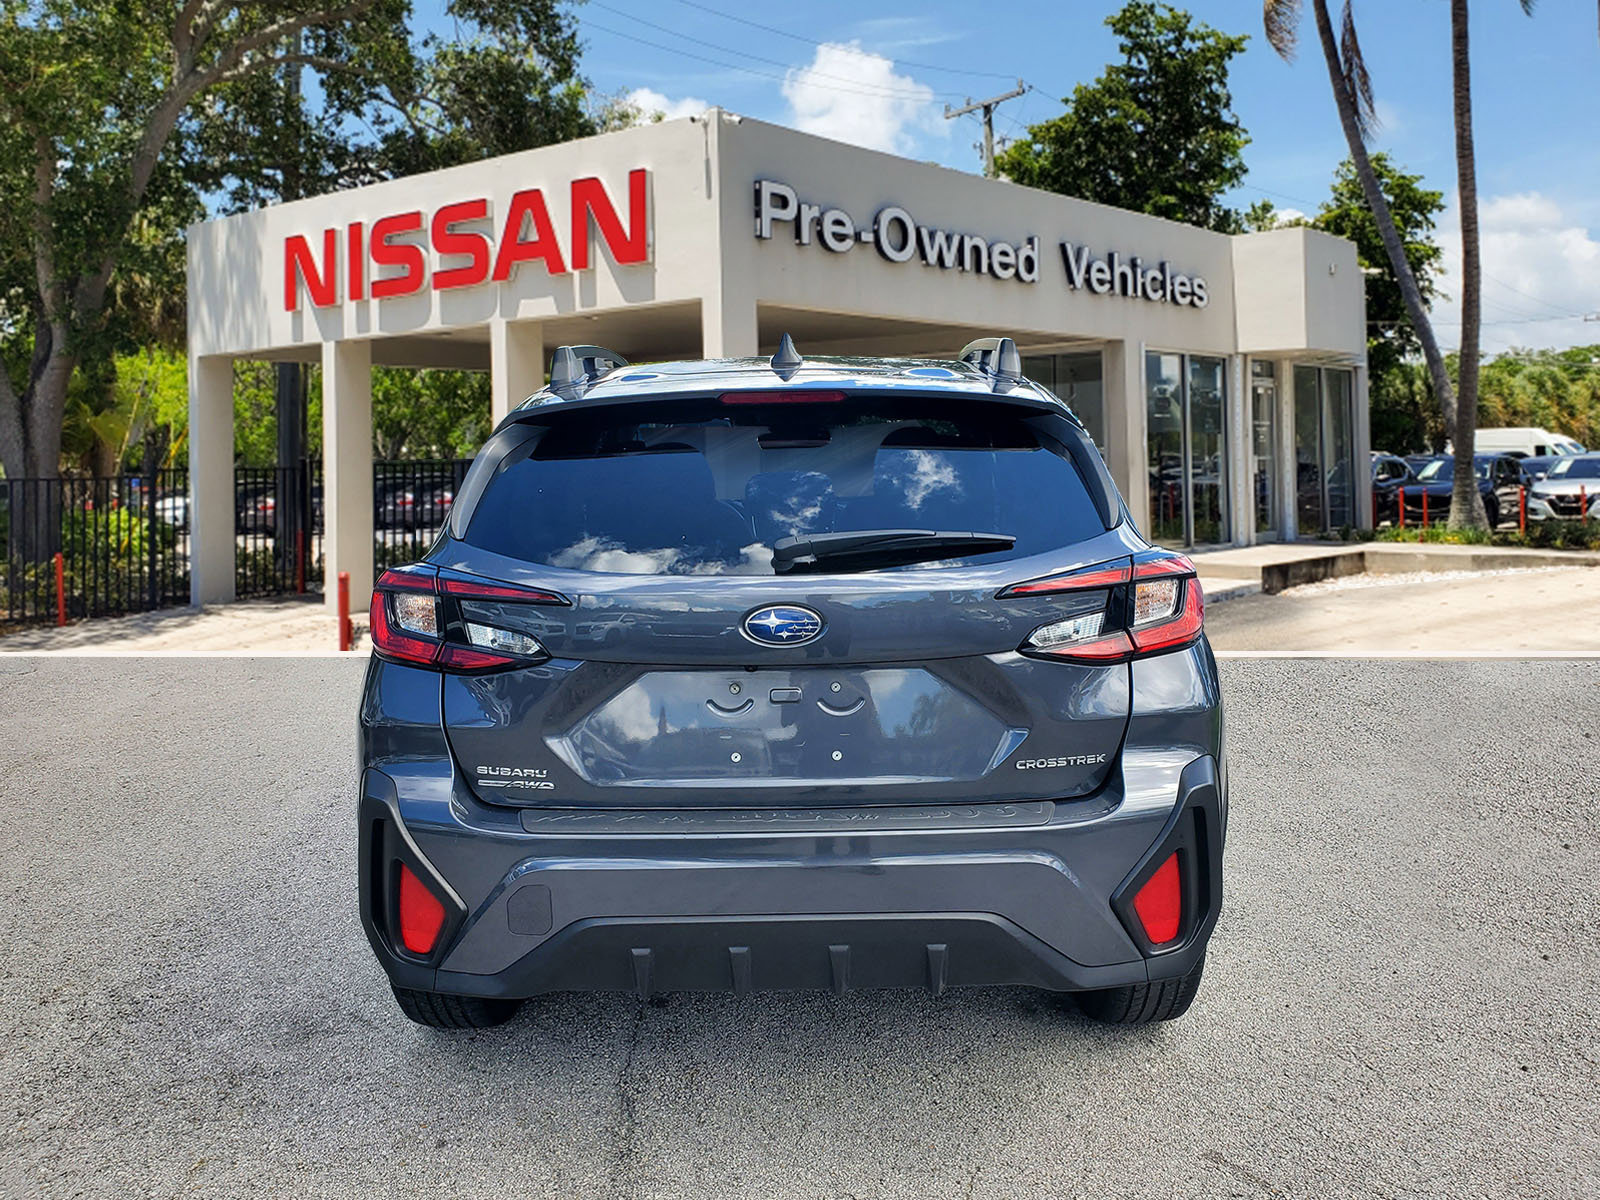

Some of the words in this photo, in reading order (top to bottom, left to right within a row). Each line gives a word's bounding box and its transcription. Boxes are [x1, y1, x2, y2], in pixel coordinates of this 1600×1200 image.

[284, 168, 649, 312] NISSAN
[755, 179, 1040, 283] Pre-Owned
[1059, 242, 1209, 308] Vehicles
[1015, 753, 1107, 770] CROSSTREK
[476, 765, 548, 778] SUBARU
[504, 780, 555, 790] AWD
